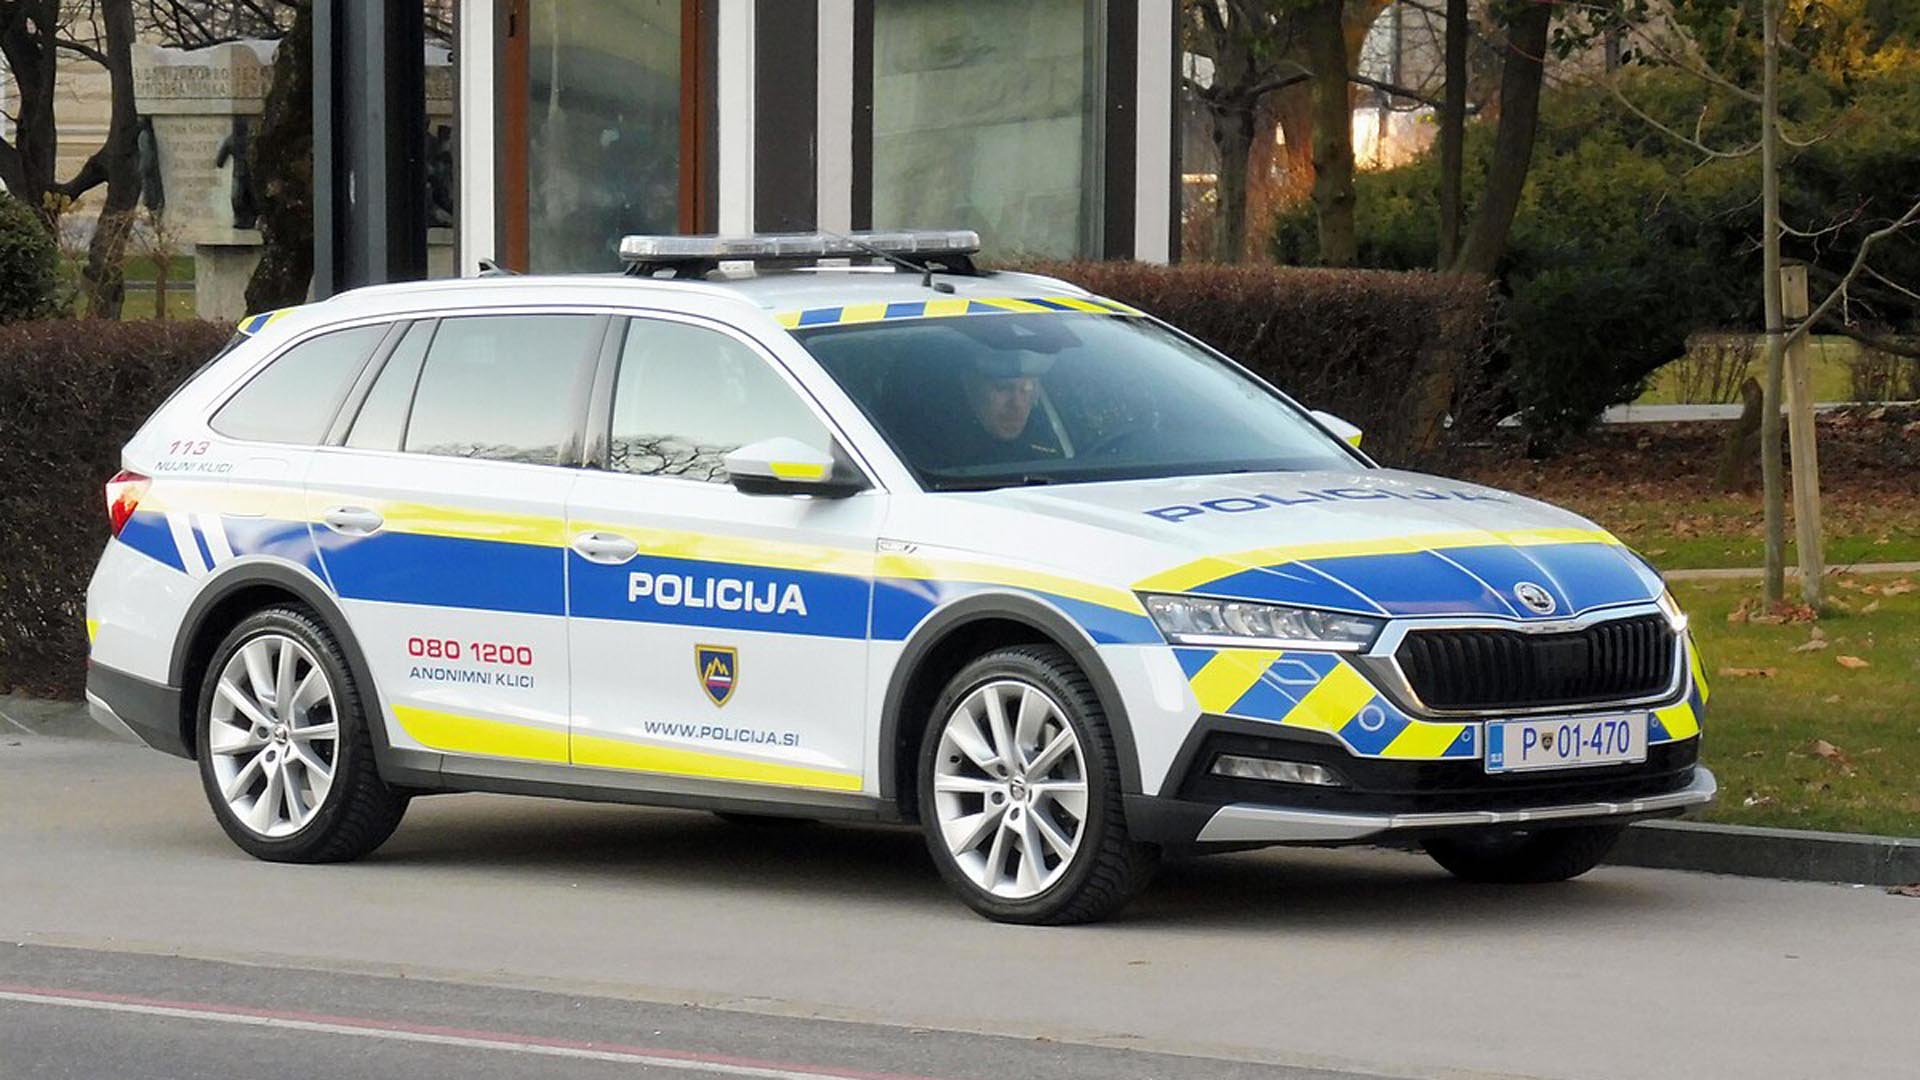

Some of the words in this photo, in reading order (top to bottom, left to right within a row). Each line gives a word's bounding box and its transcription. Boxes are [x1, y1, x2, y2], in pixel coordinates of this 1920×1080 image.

[169, 440, 212, 456] 113
[154, 461, 196, 472] NUJNI
[197, 462, 234, 473] KLICI
[1143, 488, 1513, 523] POLICIJA
[628, 572, 807, 616] POLICIJA
[408, 637, 461, 660] 080
[470, 642, 533, 666] 1200
[409, 666, 491, 685] ANONIMNI
[495, 673, 535, 688] KLICI
[644, 720, 800, 747] WWW.POLICIJA.SI
[1522, 727, 1537, 761] P
[1557, 720, 1630, 758] 01-470
